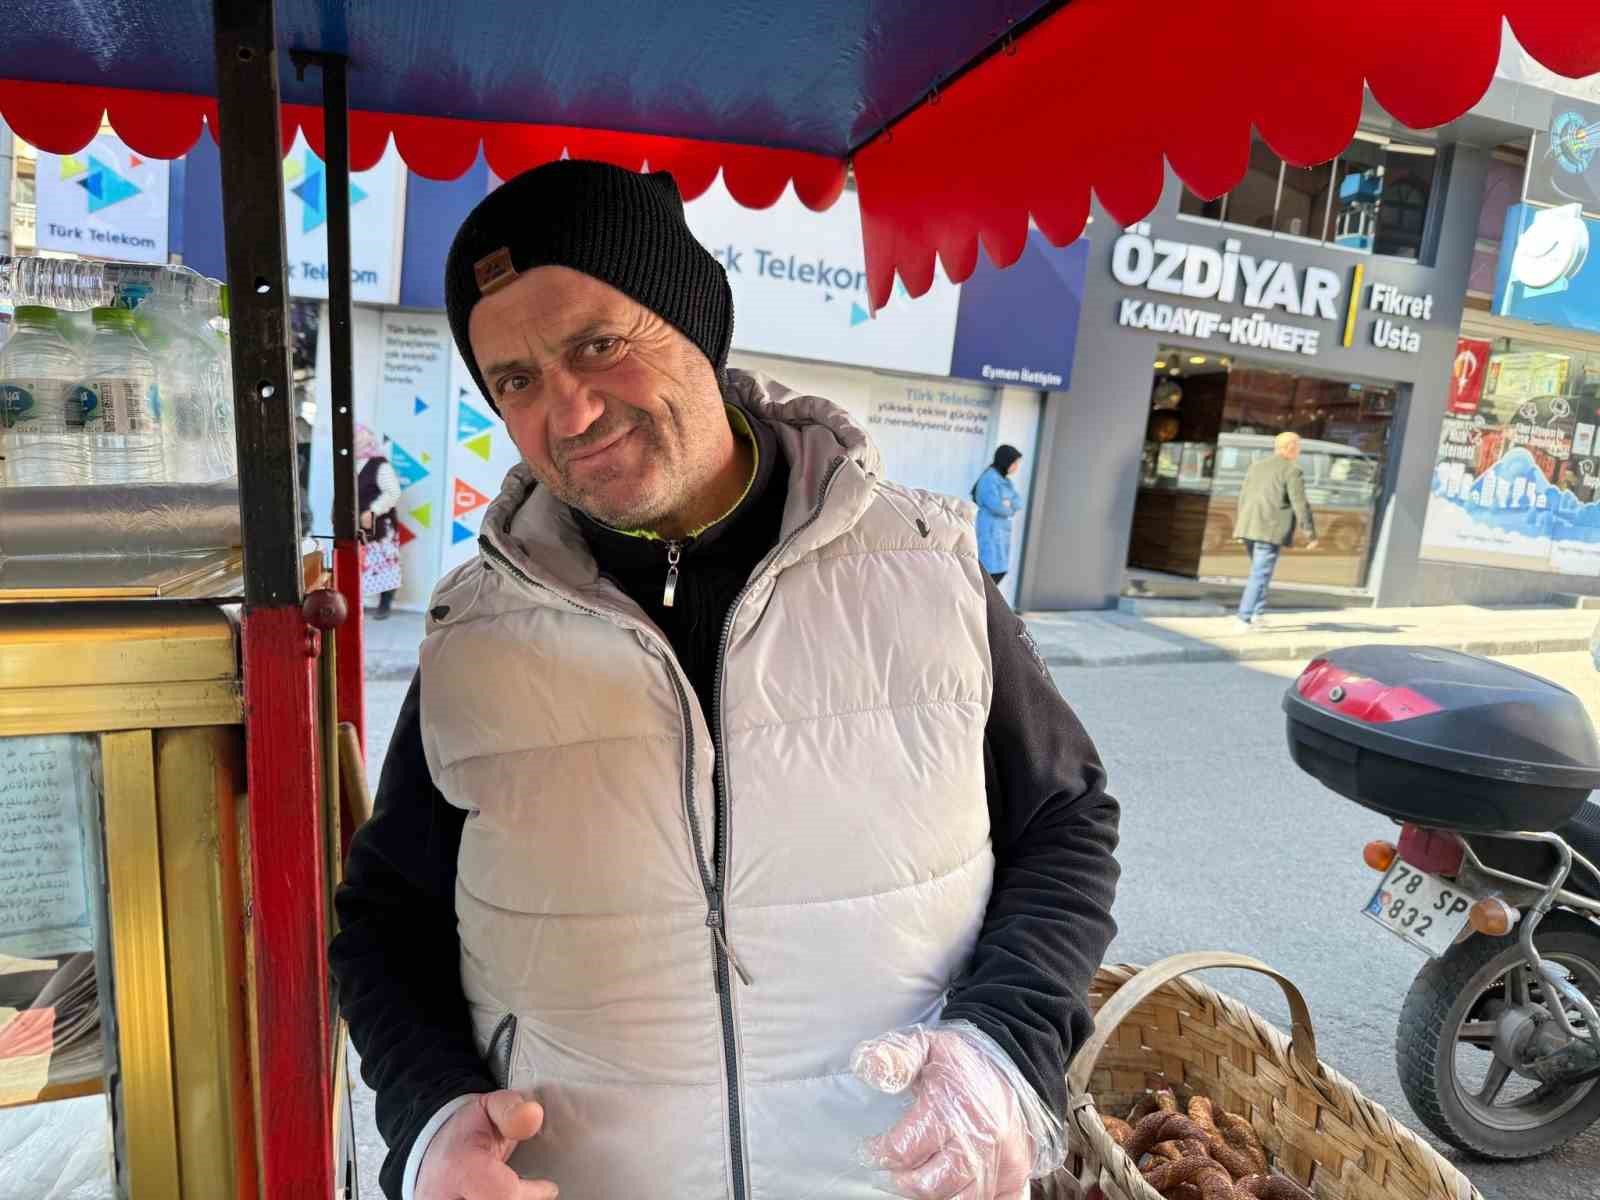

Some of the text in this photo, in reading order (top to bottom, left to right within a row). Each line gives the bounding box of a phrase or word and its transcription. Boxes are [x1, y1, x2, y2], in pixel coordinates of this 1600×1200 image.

[48, 223, 156, 249] Türk Telekom
[300, 262, 378, 284] Telom
[1111, 222, 1341, 320] ÖZDİYAR
[1369, 283, 1433, 320] Fikret
[1372, 319, 1421, 353] Usta
[905, 388, 933, 402] Türk
[1391, 866, 1468, 917] 78 SP
[1388, 898, 1433, 937] 832
